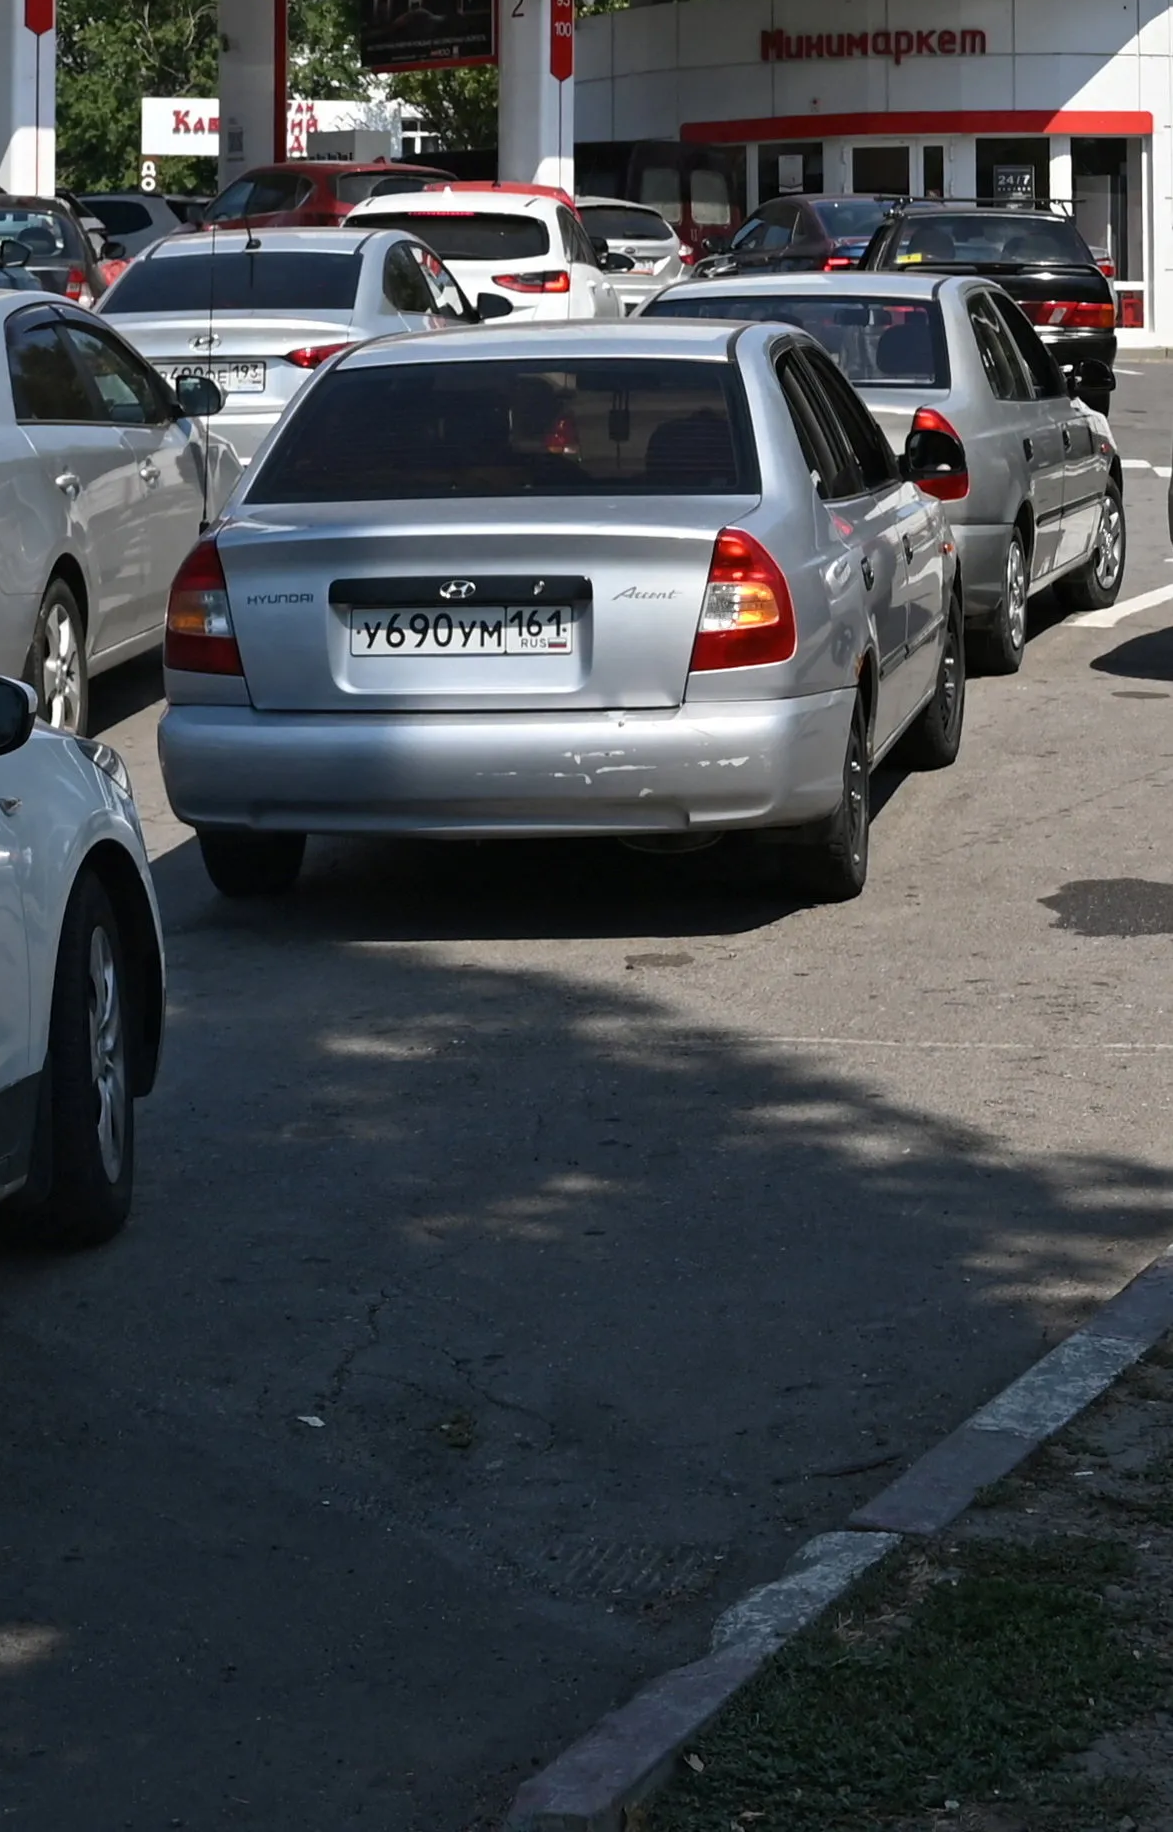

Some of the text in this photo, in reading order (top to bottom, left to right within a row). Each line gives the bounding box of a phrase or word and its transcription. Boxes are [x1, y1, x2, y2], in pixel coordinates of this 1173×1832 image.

[554, 21, 572, 38] 100
[760, 28, 987, 66] Минимаркет
[246, 593, 314, 605] HYUNDAI
[611, 585, 683, 601] Accent
[363, 610, 562, 649] У690УМ 161
[520, 637, 547, 649] RUS
